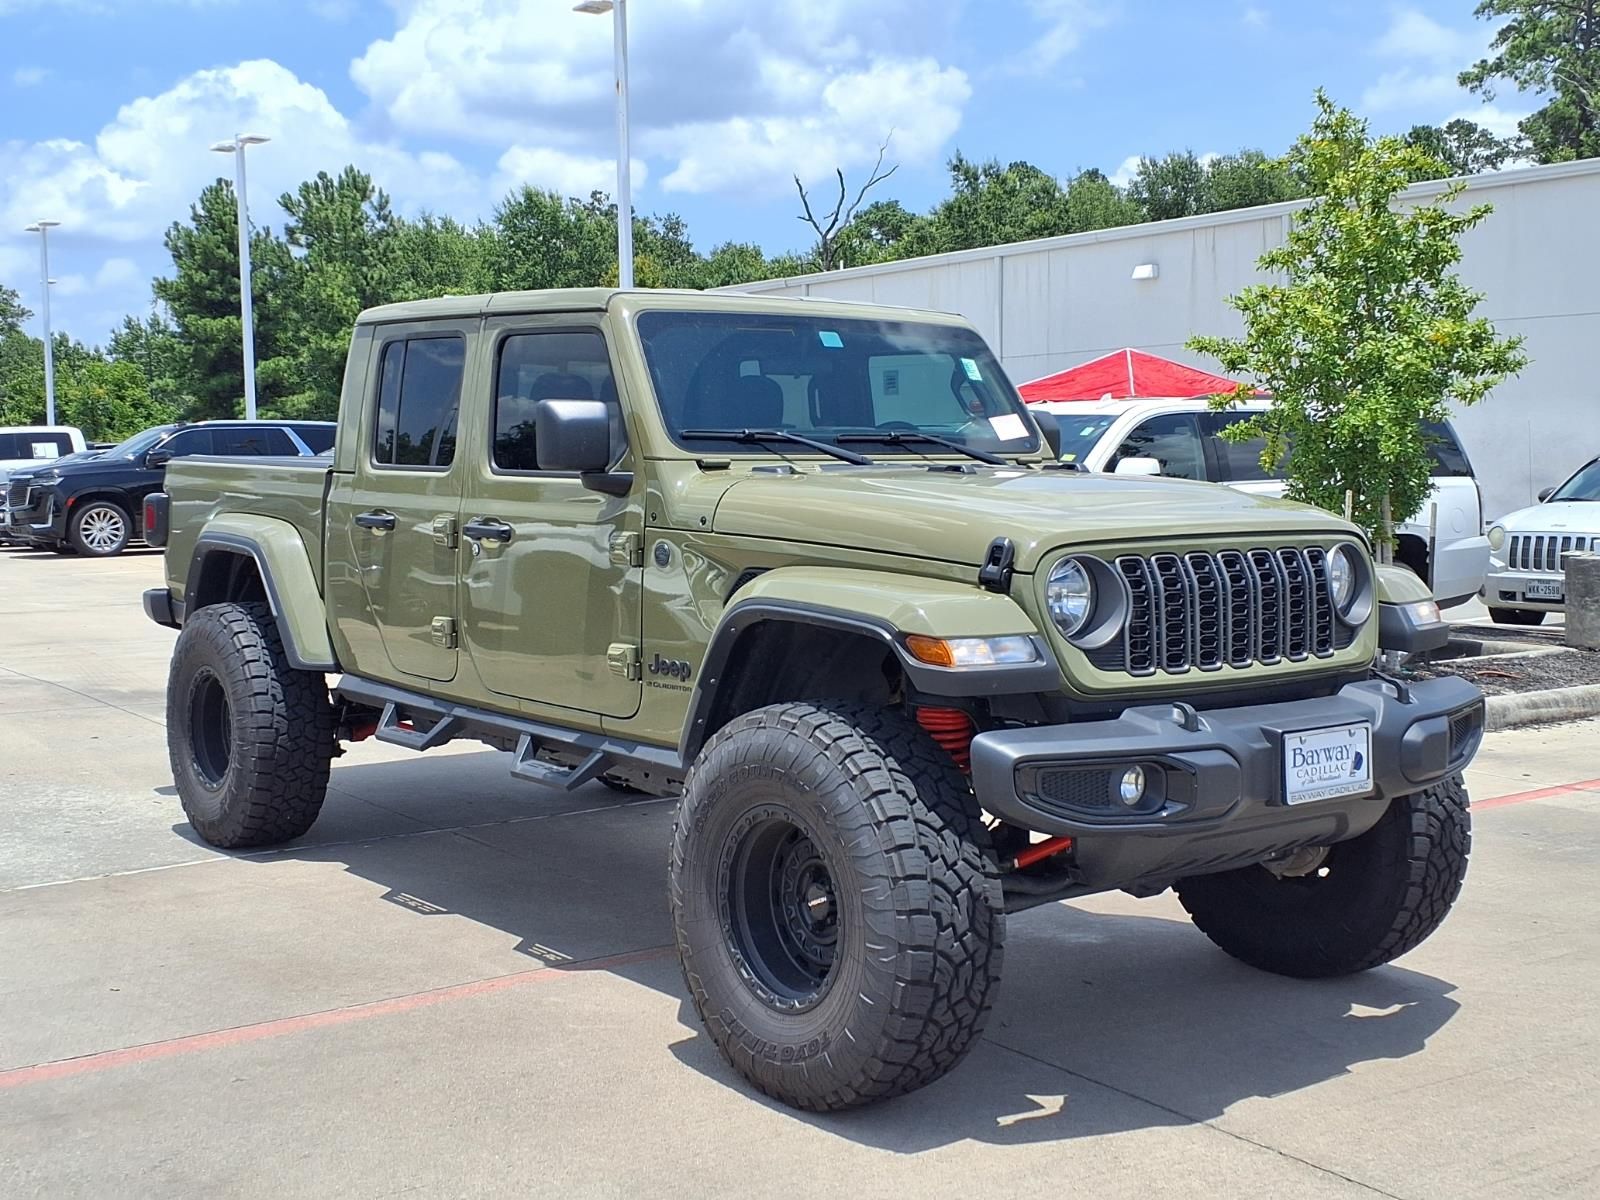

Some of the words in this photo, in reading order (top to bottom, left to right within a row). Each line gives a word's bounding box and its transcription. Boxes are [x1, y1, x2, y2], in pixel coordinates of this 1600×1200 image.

[648, 654, 691, 682] Jeep
[653, 681, 692, 692] GLADIATOR
[1297, 762, 1346, 778] CADILLAC
[1291, 791, 1326, 802] BAYWAY
[1328, 783, 1369, 796] CADILLAC
